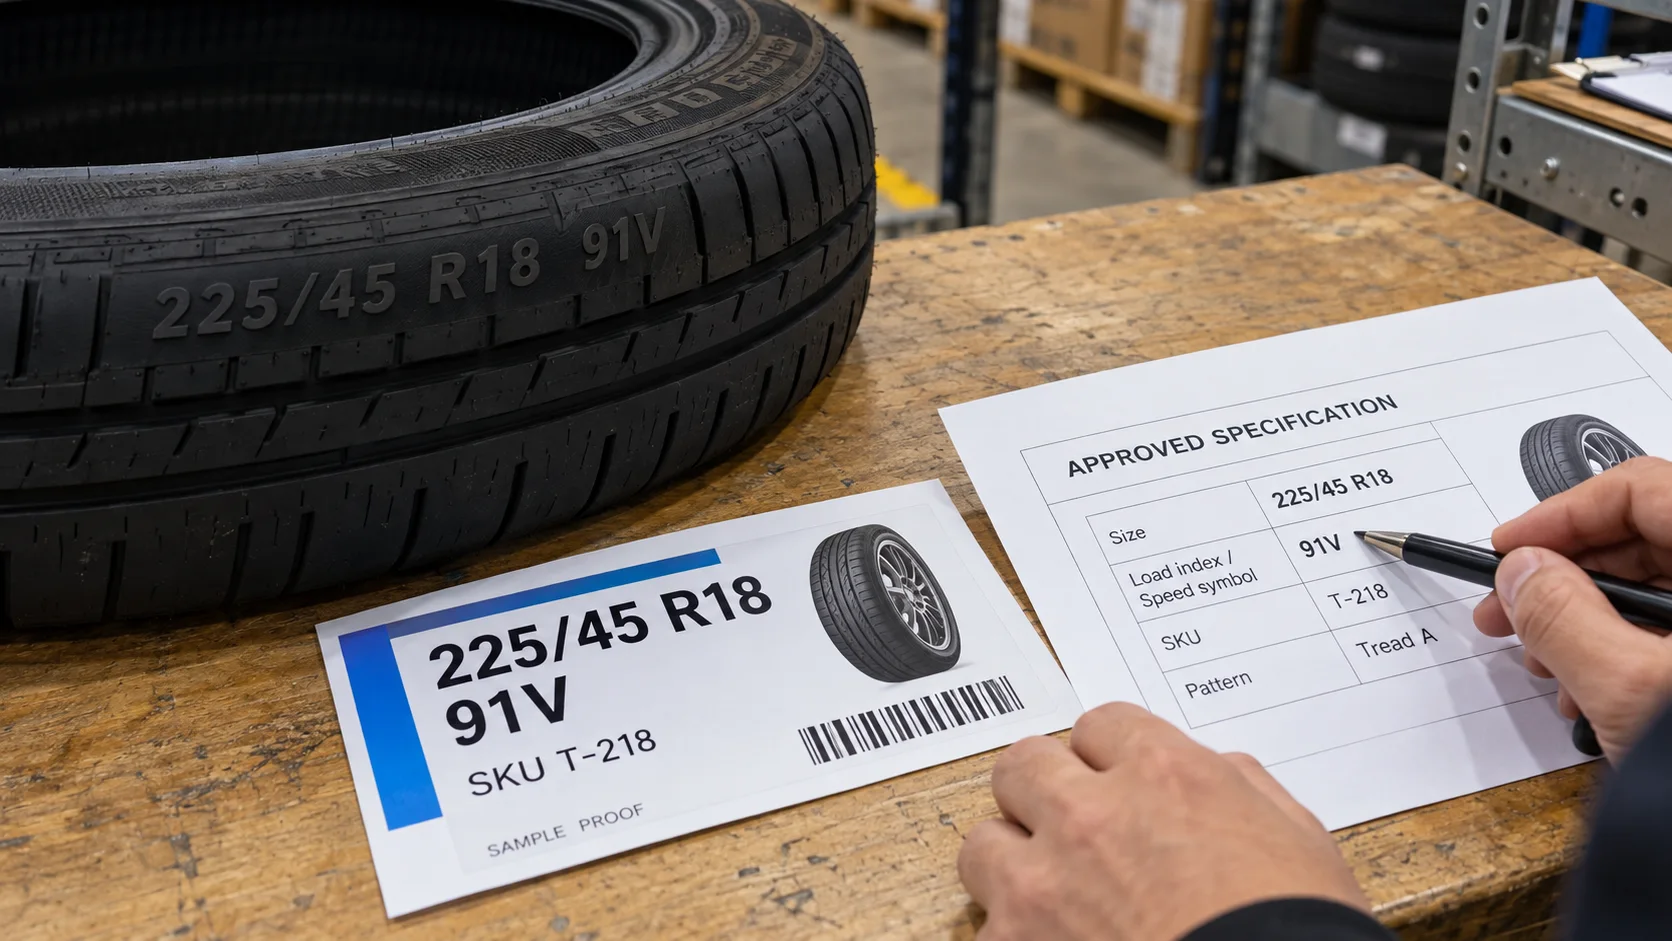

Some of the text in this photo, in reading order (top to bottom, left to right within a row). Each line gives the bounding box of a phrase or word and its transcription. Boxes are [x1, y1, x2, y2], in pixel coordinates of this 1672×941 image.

[152, 206, 667, 340] 225/45 R18 91V
[1068, 394, 1398, 478] APPROVED SPECIFICATION
[1271, 468, 1394, 509] 225/45 R18
[1109, 525, 1147, 546] Size
[1299, 534, 1341, 559] 91V
[1129, 550, 1233, 588] Load index /
[1139, 568, 1258, 610] Speed symbol
[1328, 583, 1389, 610] T-218
[428, 575, 772, 690] 225/45 R18
[1161, 629, 1202, 652] SKU
[1356, 627, 1438, 659] Tread A
[1185, 670, 1252, 699] Pattern
[445, 675, 567, 746] 91V
[468, 729, 657, 797] SKU T-218
[487, 803, 644, 857] SAMPLE PROOF
